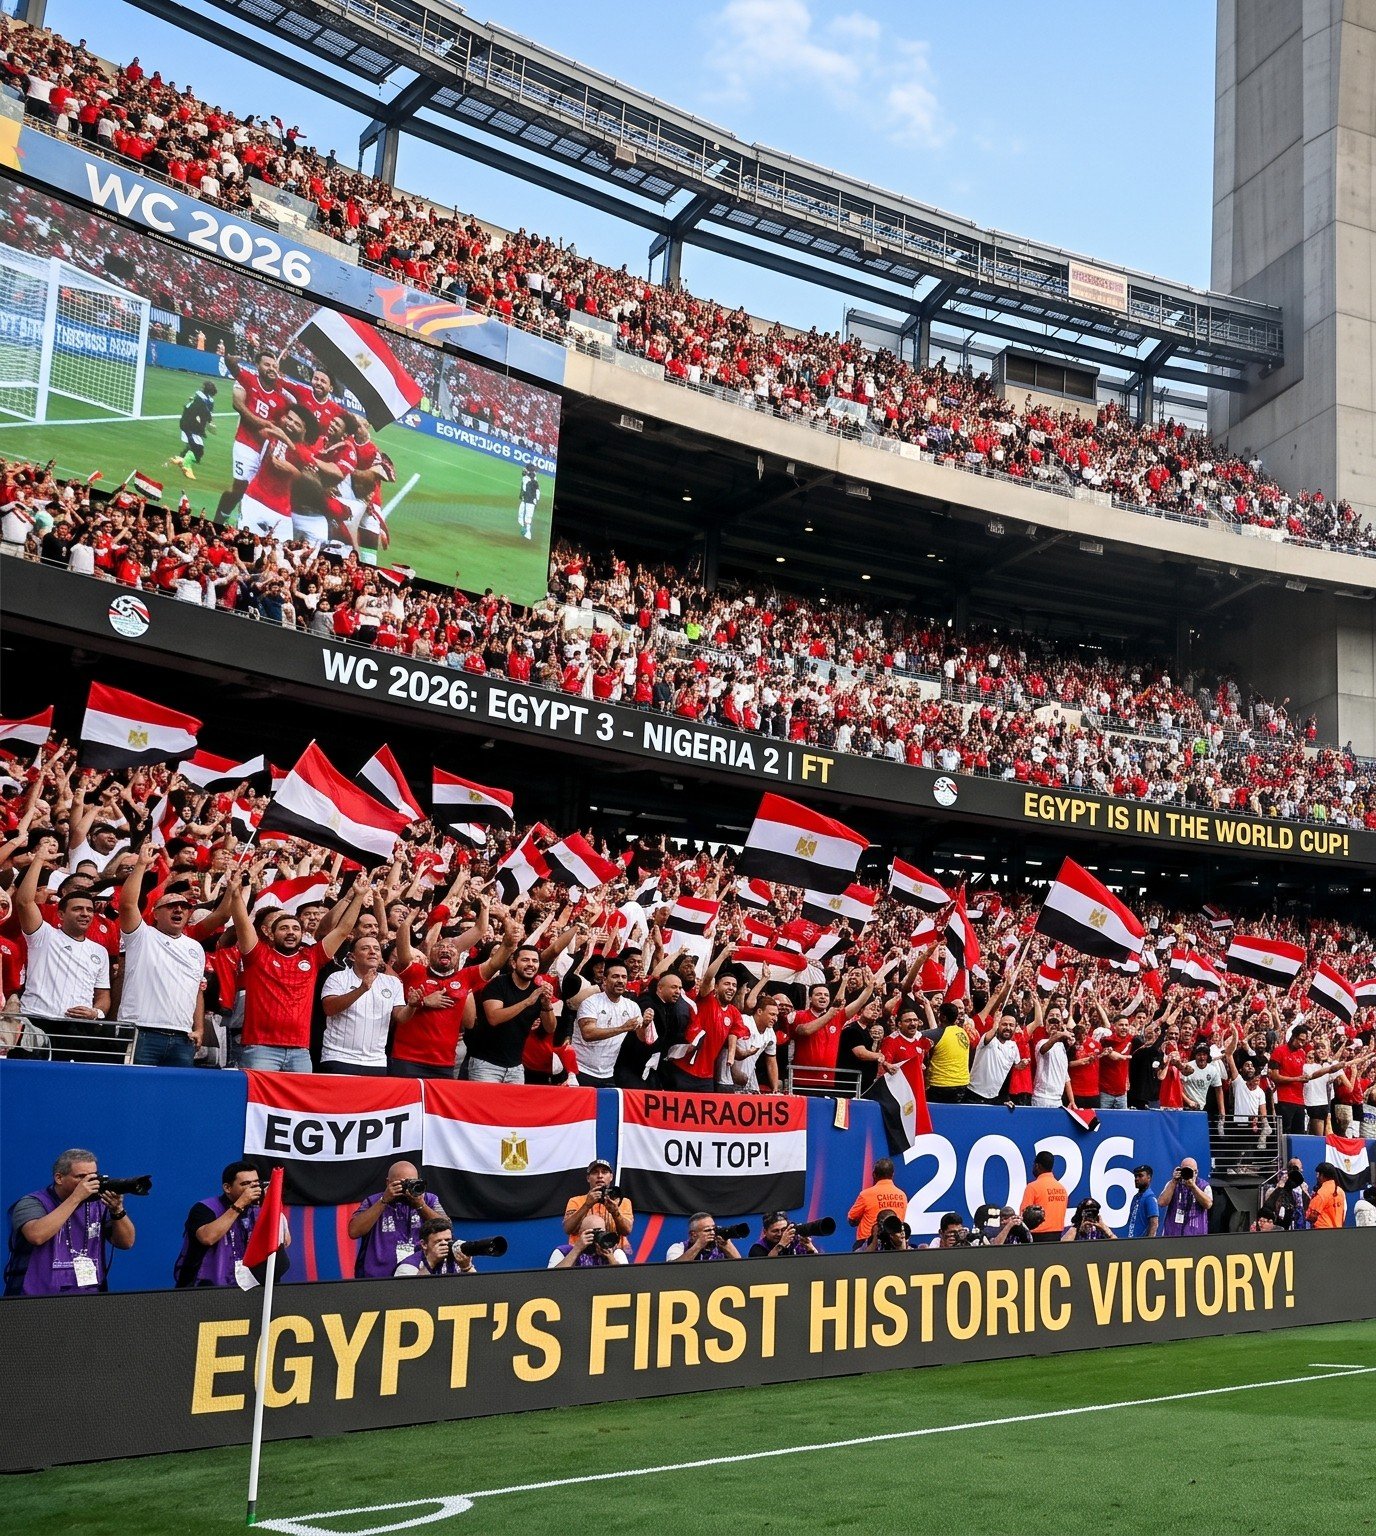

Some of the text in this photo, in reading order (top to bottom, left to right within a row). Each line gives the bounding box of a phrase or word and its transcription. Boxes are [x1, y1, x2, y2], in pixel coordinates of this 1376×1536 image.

[85, 162, 312, 287] WC 2026
[322, 648, 379, 690] WC
[387, 665, 478, 713] 2026:
[488, 687, 589, 736] EGYPT
[596, 712, 614, 742] 3
[643, 721, 756, 771] NIGERIA
[763, 747, 779, 775] 2
[801, 753, 835, 784] FT
[1024, 791, 1349, 856] EGYPT IS IN THE WORLD CUP!
[264, 1112, 410, 1156] EGYPT
[643, 1093, 790, 1127] PHARAOHS
[664, 1138, 770, 1168] ON TOP!
[903, 1133, 1136, 1235] 2026
[191, 1250, 1296, 1415] EGYPT'S FIRST HISTORIC VICTORY!
